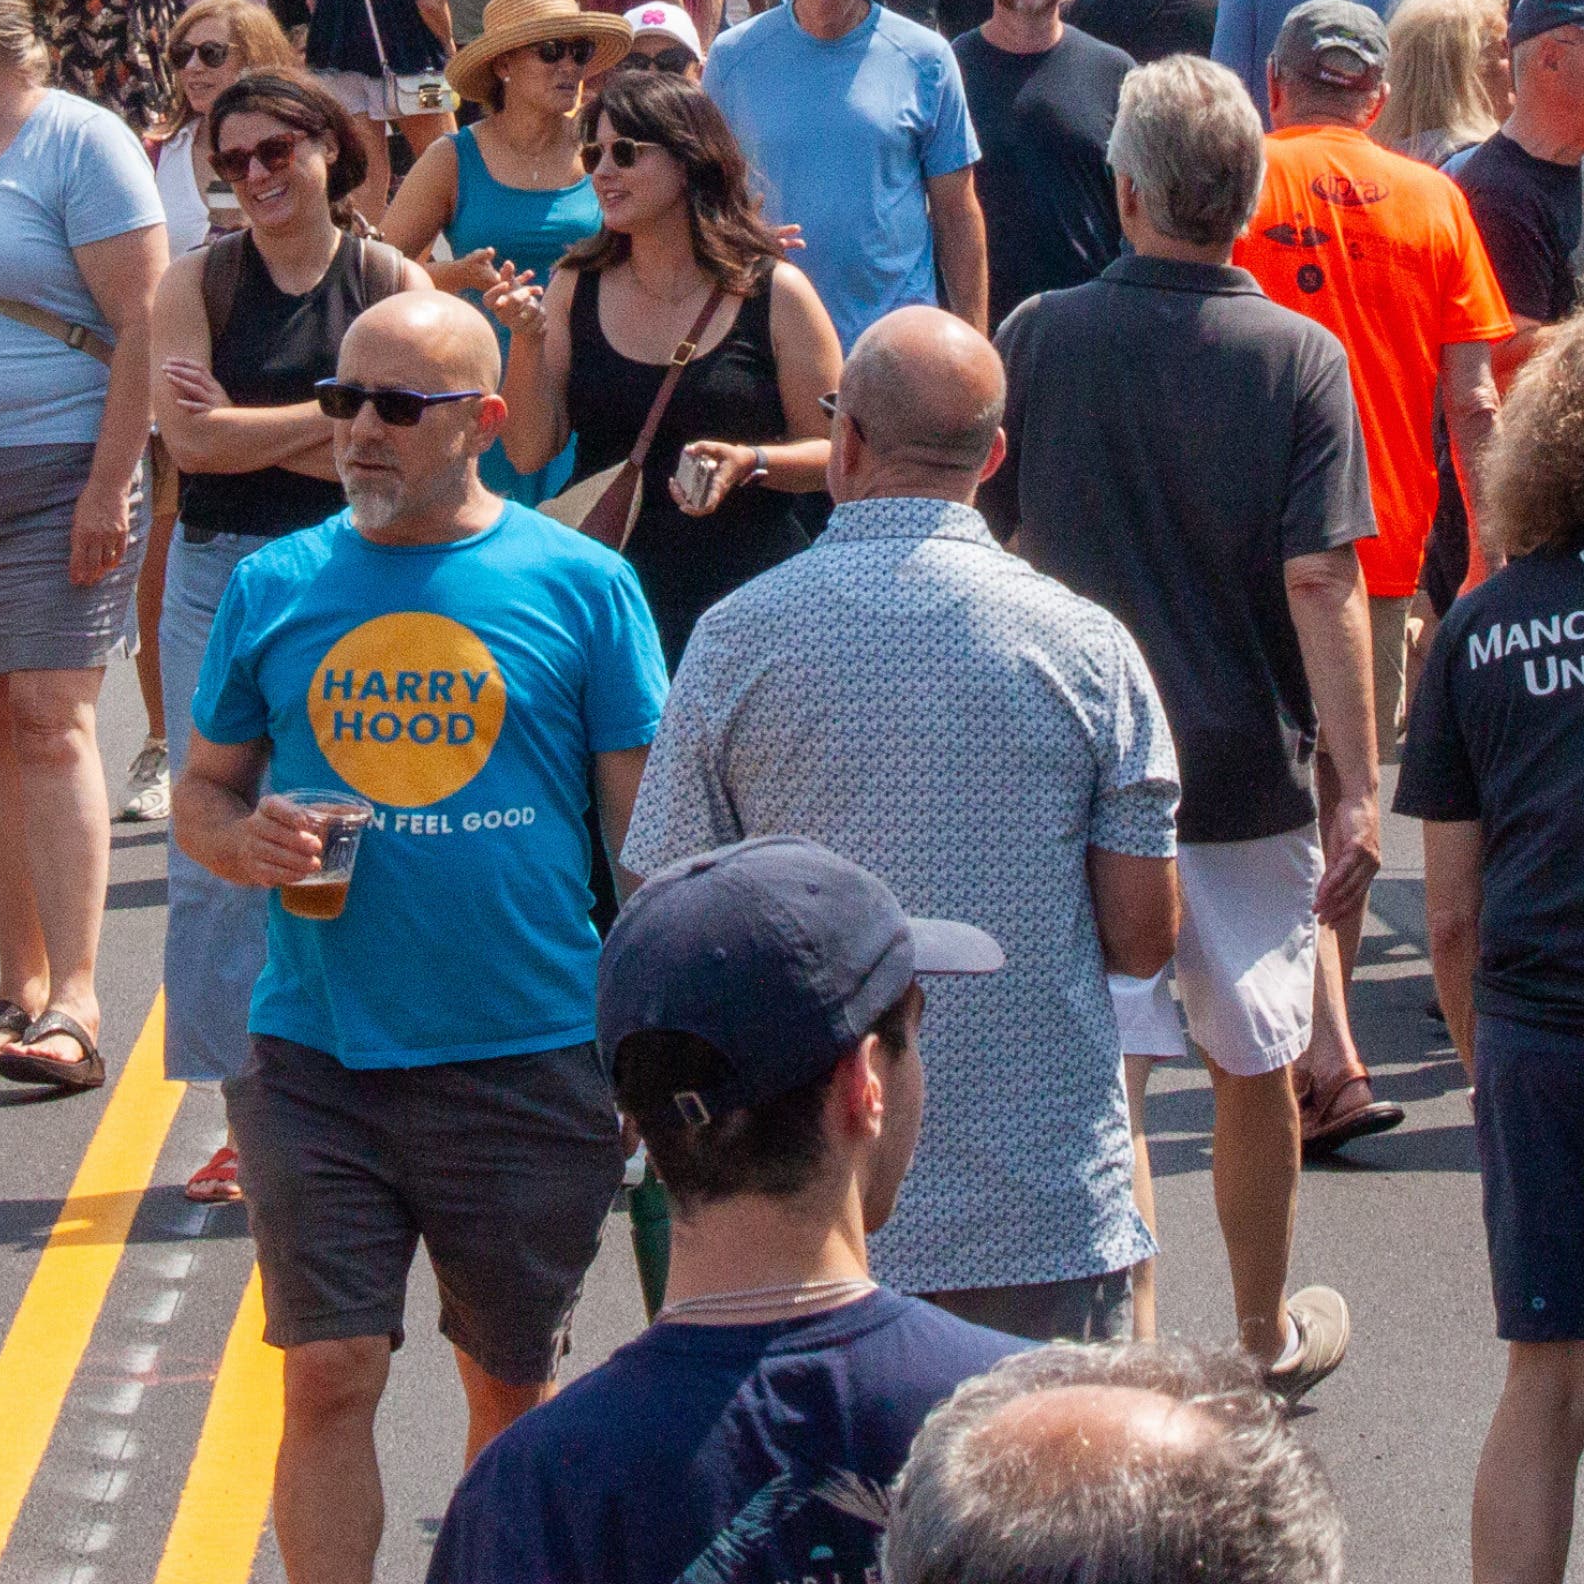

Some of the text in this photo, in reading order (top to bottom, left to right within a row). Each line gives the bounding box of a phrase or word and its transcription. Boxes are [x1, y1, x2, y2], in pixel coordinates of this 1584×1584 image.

[323, 669, 490, 703] HARRY
[333, 710, 476, 746] HOOD
[394, 813, 454, 836] FEEL
[462, 806, 536, 832] GOOD
